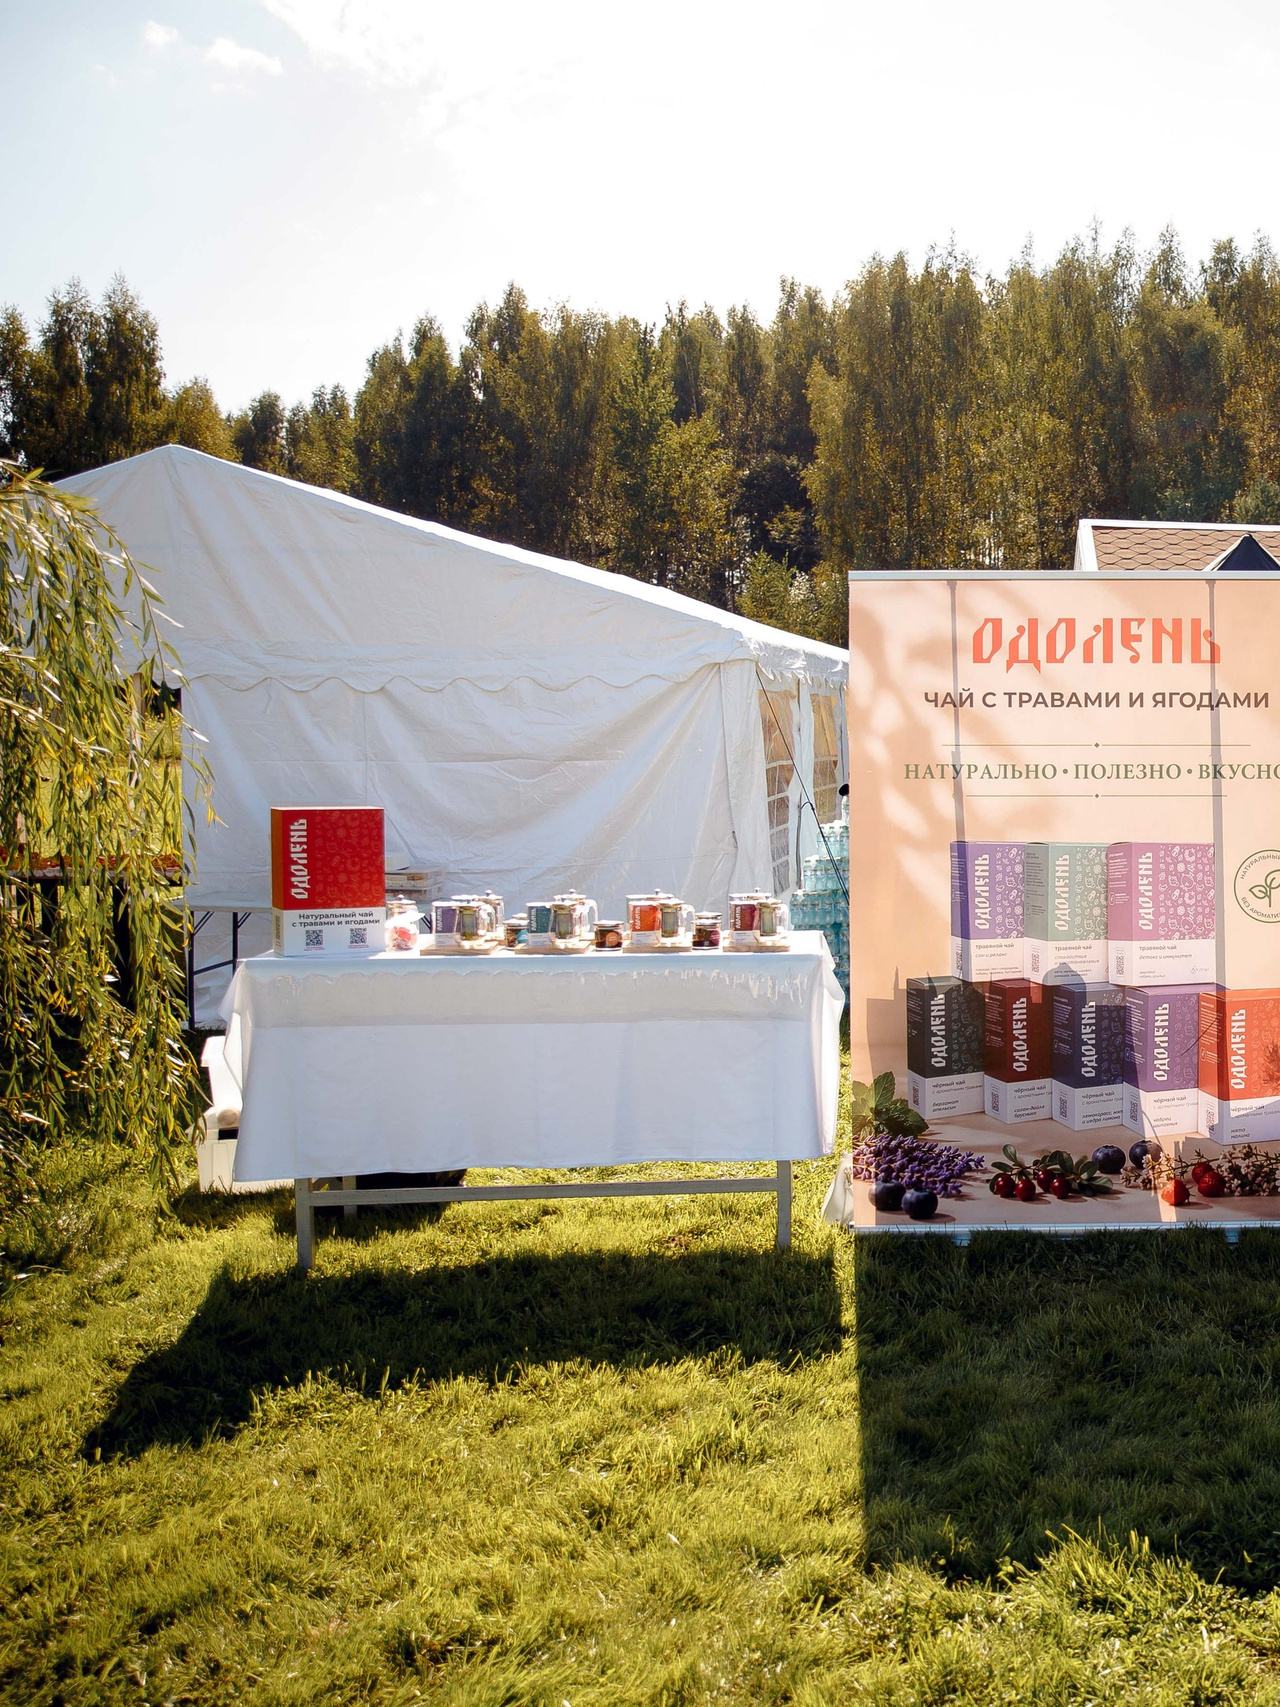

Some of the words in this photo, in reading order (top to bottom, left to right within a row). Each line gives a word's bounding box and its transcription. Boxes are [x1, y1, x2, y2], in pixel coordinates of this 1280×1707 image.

[972, 618, 1221, 674] ОДОЛЕНЬ
[924, 688, 974, 709] ЧАЙ
[982, 692, 997, 709] С
[1005, 692, 1120, 709] ТРАВАМИ
[1129, 692, 1145, 709] И
[1152, 692, 1270, 712] ЯГОДАМИ
[904, 763, 1057, 780] НАТУРАЛЬНО
[1073, 763, 1182, 780] ПОЛЕЗНО
[290, 818, 311, 899] ОДОЛЕНЬ
[974, 854, 992, 930] ОДОЛЕНЬ
[1054, 854, 1071, 931] ОДОЛЕНЬ
[1138, 852, 1155, 930] ОДОЛЕНЬ
[298, 911, 356, 921] Натуральный
[299, 920, 335, 928] травами
[345, 918, 380, 926] ягодами
[1241, 896, 1251, 909] БЕЗ
[930, 993, 948, 1068] ОДОЛЕНЬ
[1012, 997, 1029, 1072] ОДОЛЕНЬ
[1081, 1001, 1098, 1078] ОДОЛЕНЬ
[1153, 1003, 1170, 1081] ОДОЛЕНЬ
[1230, 1009, 1248, 1090] ОДОЛЕНЬ
